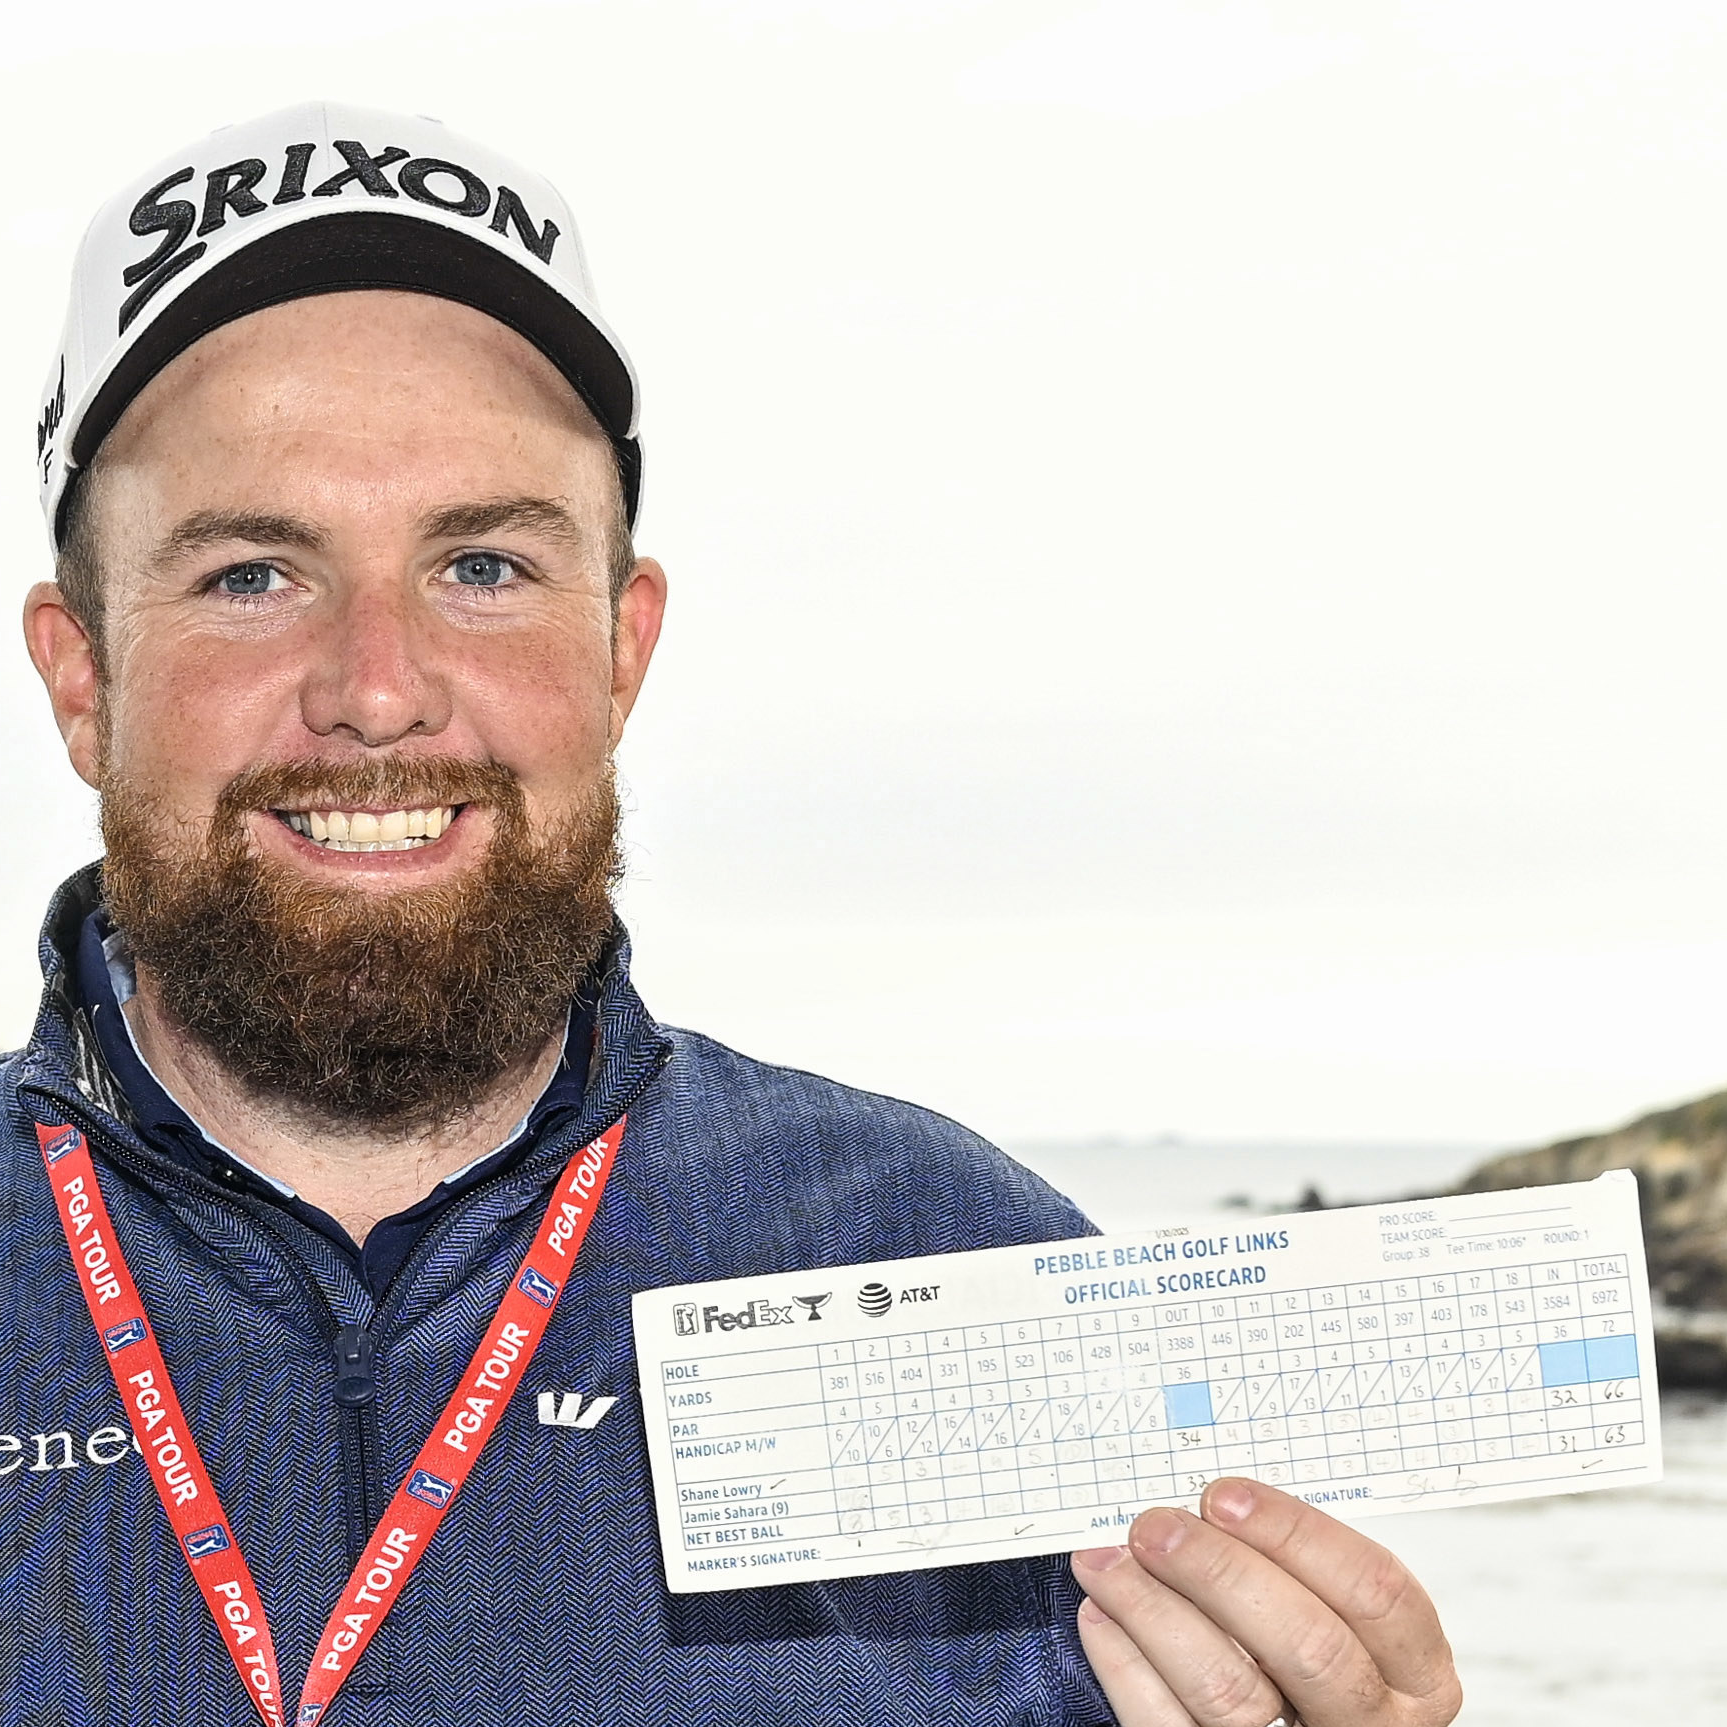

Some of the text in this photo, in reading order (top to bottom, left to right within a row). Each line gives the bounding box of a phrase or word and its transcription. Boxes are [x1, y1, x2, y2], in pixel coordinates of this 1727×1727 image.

[119, 140, 561, 336] SRIXON
[547, 1137, 609, 1256] PGA TOUR
[1379, 1211, 1437, 1226] PRO SCORE:
[63, 1176, 121, 1305] PGA TOUR
[1381, 1227, 1447, 1244] TEAM SCORE:
[1383, 1251, 1415, 1262] Group:
[1419, 1247, 1430, 1258] 38
[1446, 1244, 1464, 1254] Tee
[1467, 1242, 1495, 1251] Time:
[1544, 1231, 1582, 1243] ROUND:
[1034, 1230, 1289, 1276] PEBBLE BEACH GOLF LINKS
[899, 1285, 941, 1304] AT&T
[1065, 1266, 1266, 1304] OFFICIAL SCORECARD
[665, 1364, 700, 1380] HOLE
[868, 1344, 876, 1357] 2
[905, 1340, 912, 1353] 3
[942, 1336, 949, 1348] 4
[980, 1331, 987, 1344] 5
[1018, 1327, 1025, 1339] 6
[1057, 1322, 1062, 1335] 7
[1094, 1318, 1101, 1331] 8
[1132, 1314, 1139, 1327] 9
[1165, 1308, 1188, 1322] OUT
[1212, 1304, 1224, 1317] 10
[1249, 1301, 1259, 1313] 11
[1285, 1297, 1297, 1309] 12
[1322, 1293, 1334, 1305] 13
[1359, 1289, 1371, 1301] 14
[1395, 1285, 1407, 1297] 15
[1433, 1281, 1445, 1293] 16
[1470, 1276, 1480, 1288] 17
[1506, 1272, 1518, 1285] 18
[1547, 1268, 1559, 1280] IN
[1582, 1262, 1622, 1277] TOTAL
[702, 1300, 794, 1333] FedEx
[668, 1391, 712, 1408] YARDS
[829, 1376, 849, 1390] 381
[865, 1371, 885, 1386] 516
[900, 1367, 922, 1381] 404
[940, 1363, 958, 1377] 331
[977, 1358, 997, 1372] 195
[1015, 1354, 1034, 1368] 523
[1053, 1350, 1073, 1363] 106
[1091, 1346, 1112, 1359] 428
[1128, 1342, 1150, 1355] 504
[1211, 1332, 1232, 1345] 446
[1247, 1328, 1268, 1342] 390
[1284, 1324, 1304, 1338] 202
[1321, 1320, 1342, 1333] 445
[1357, 1316, 1378, 1330] 580
[1394, 1312, 1413, 1326] 397
[1431, 1308, 1452, 1321] 403
[1469, 1304, 1488, 1317] 178
[443, 1321, 530, 1452] PGA TOUR
[672, 1320, 1615, 1437] PAR 4 5 4 4 3 5 3 36 4 4 3 4 5 4 4 3 5 36 72
[1604, 1381, 1624, 1400] 66
[675, 1353, 1517, 1460] HANDICAP M/W 6 10 12 16 14 2 18 4 17 13 11 15 5
[128, 1370, 198, 1506] PGA TOUR
[1176, 1430, 1202, 1447] 34
[1605, 1426, 1626, 1444] 63
[681, 1483, 762, 1502] Shane Lowry
[1304, 1487, 1373, 1503] SIGNATURE:
[684, 1501, 789, 1523] Jamie Sahara (9)
[1091, 1516, 1109, 1528] AM
[686, 1524, 784, 1545] NET BEST BALL
[687, 1548, 821, 1572] MARKER'S SIGNATURE:
[213, 1581, 258, 1645] PGA
[321, 1526, 418, 1672] PGA TOUR
